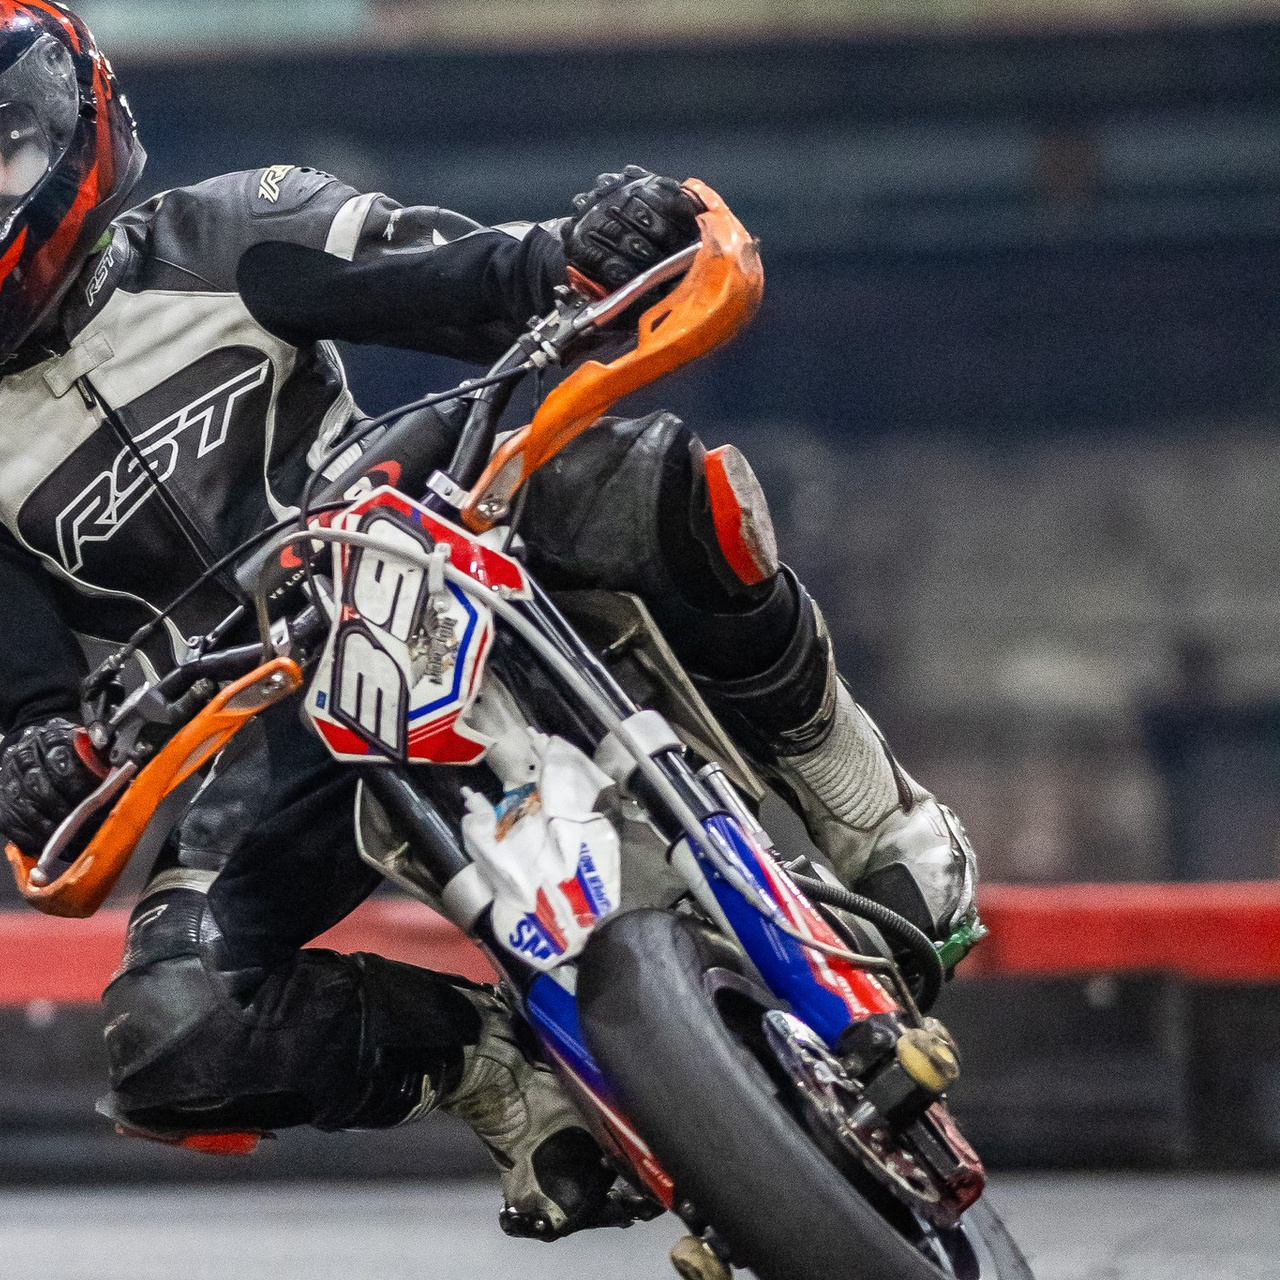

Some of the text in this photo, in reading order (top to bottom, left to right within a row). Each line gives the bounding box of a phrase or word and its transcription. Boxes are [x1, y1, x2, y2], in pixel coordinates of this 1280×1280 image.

[85, 245, 114, 307] RST
[56, 360, 270, 574] RST
[331, 506, 432, 762] 39
